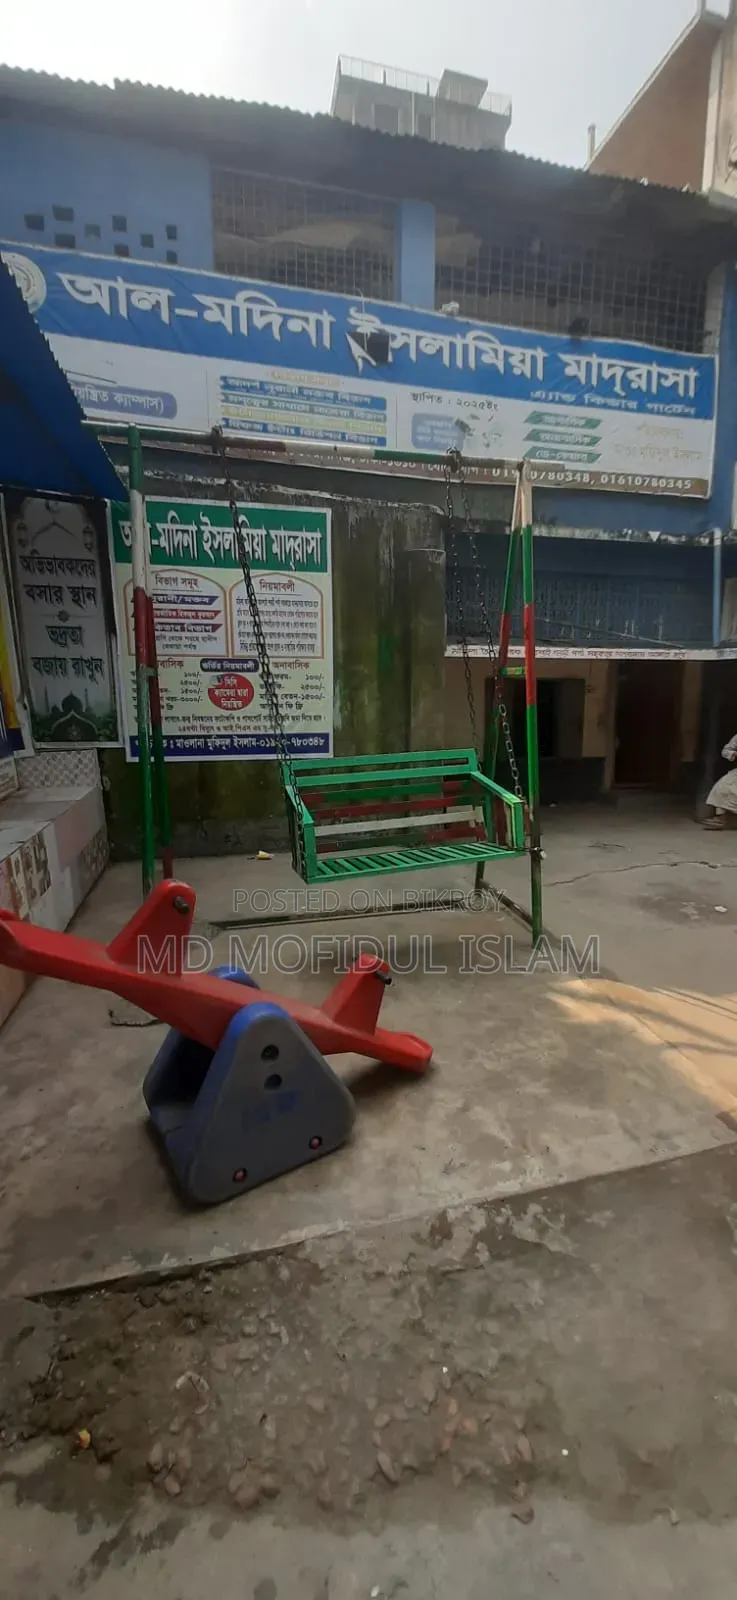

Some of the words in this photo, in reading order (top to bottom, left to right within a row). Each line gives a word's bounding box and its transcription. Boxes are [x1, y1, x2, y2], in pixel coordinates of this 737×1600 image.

[55, 272, 337, 351] আল-মদিনা
[600, 473, 692, 490] 01610780345
[155, 574, 178, 586] বিভাগ
[180, 576, 200, 588] সমূহ
[259, 578, 295, 592] নিয়মাবলী
[23, 583, 65, 605] বসার
[67, 584, 98, 609] স্থান
[30, 656, 69, 679] বজায়
[70, 656, 105, 685] রাখুন
